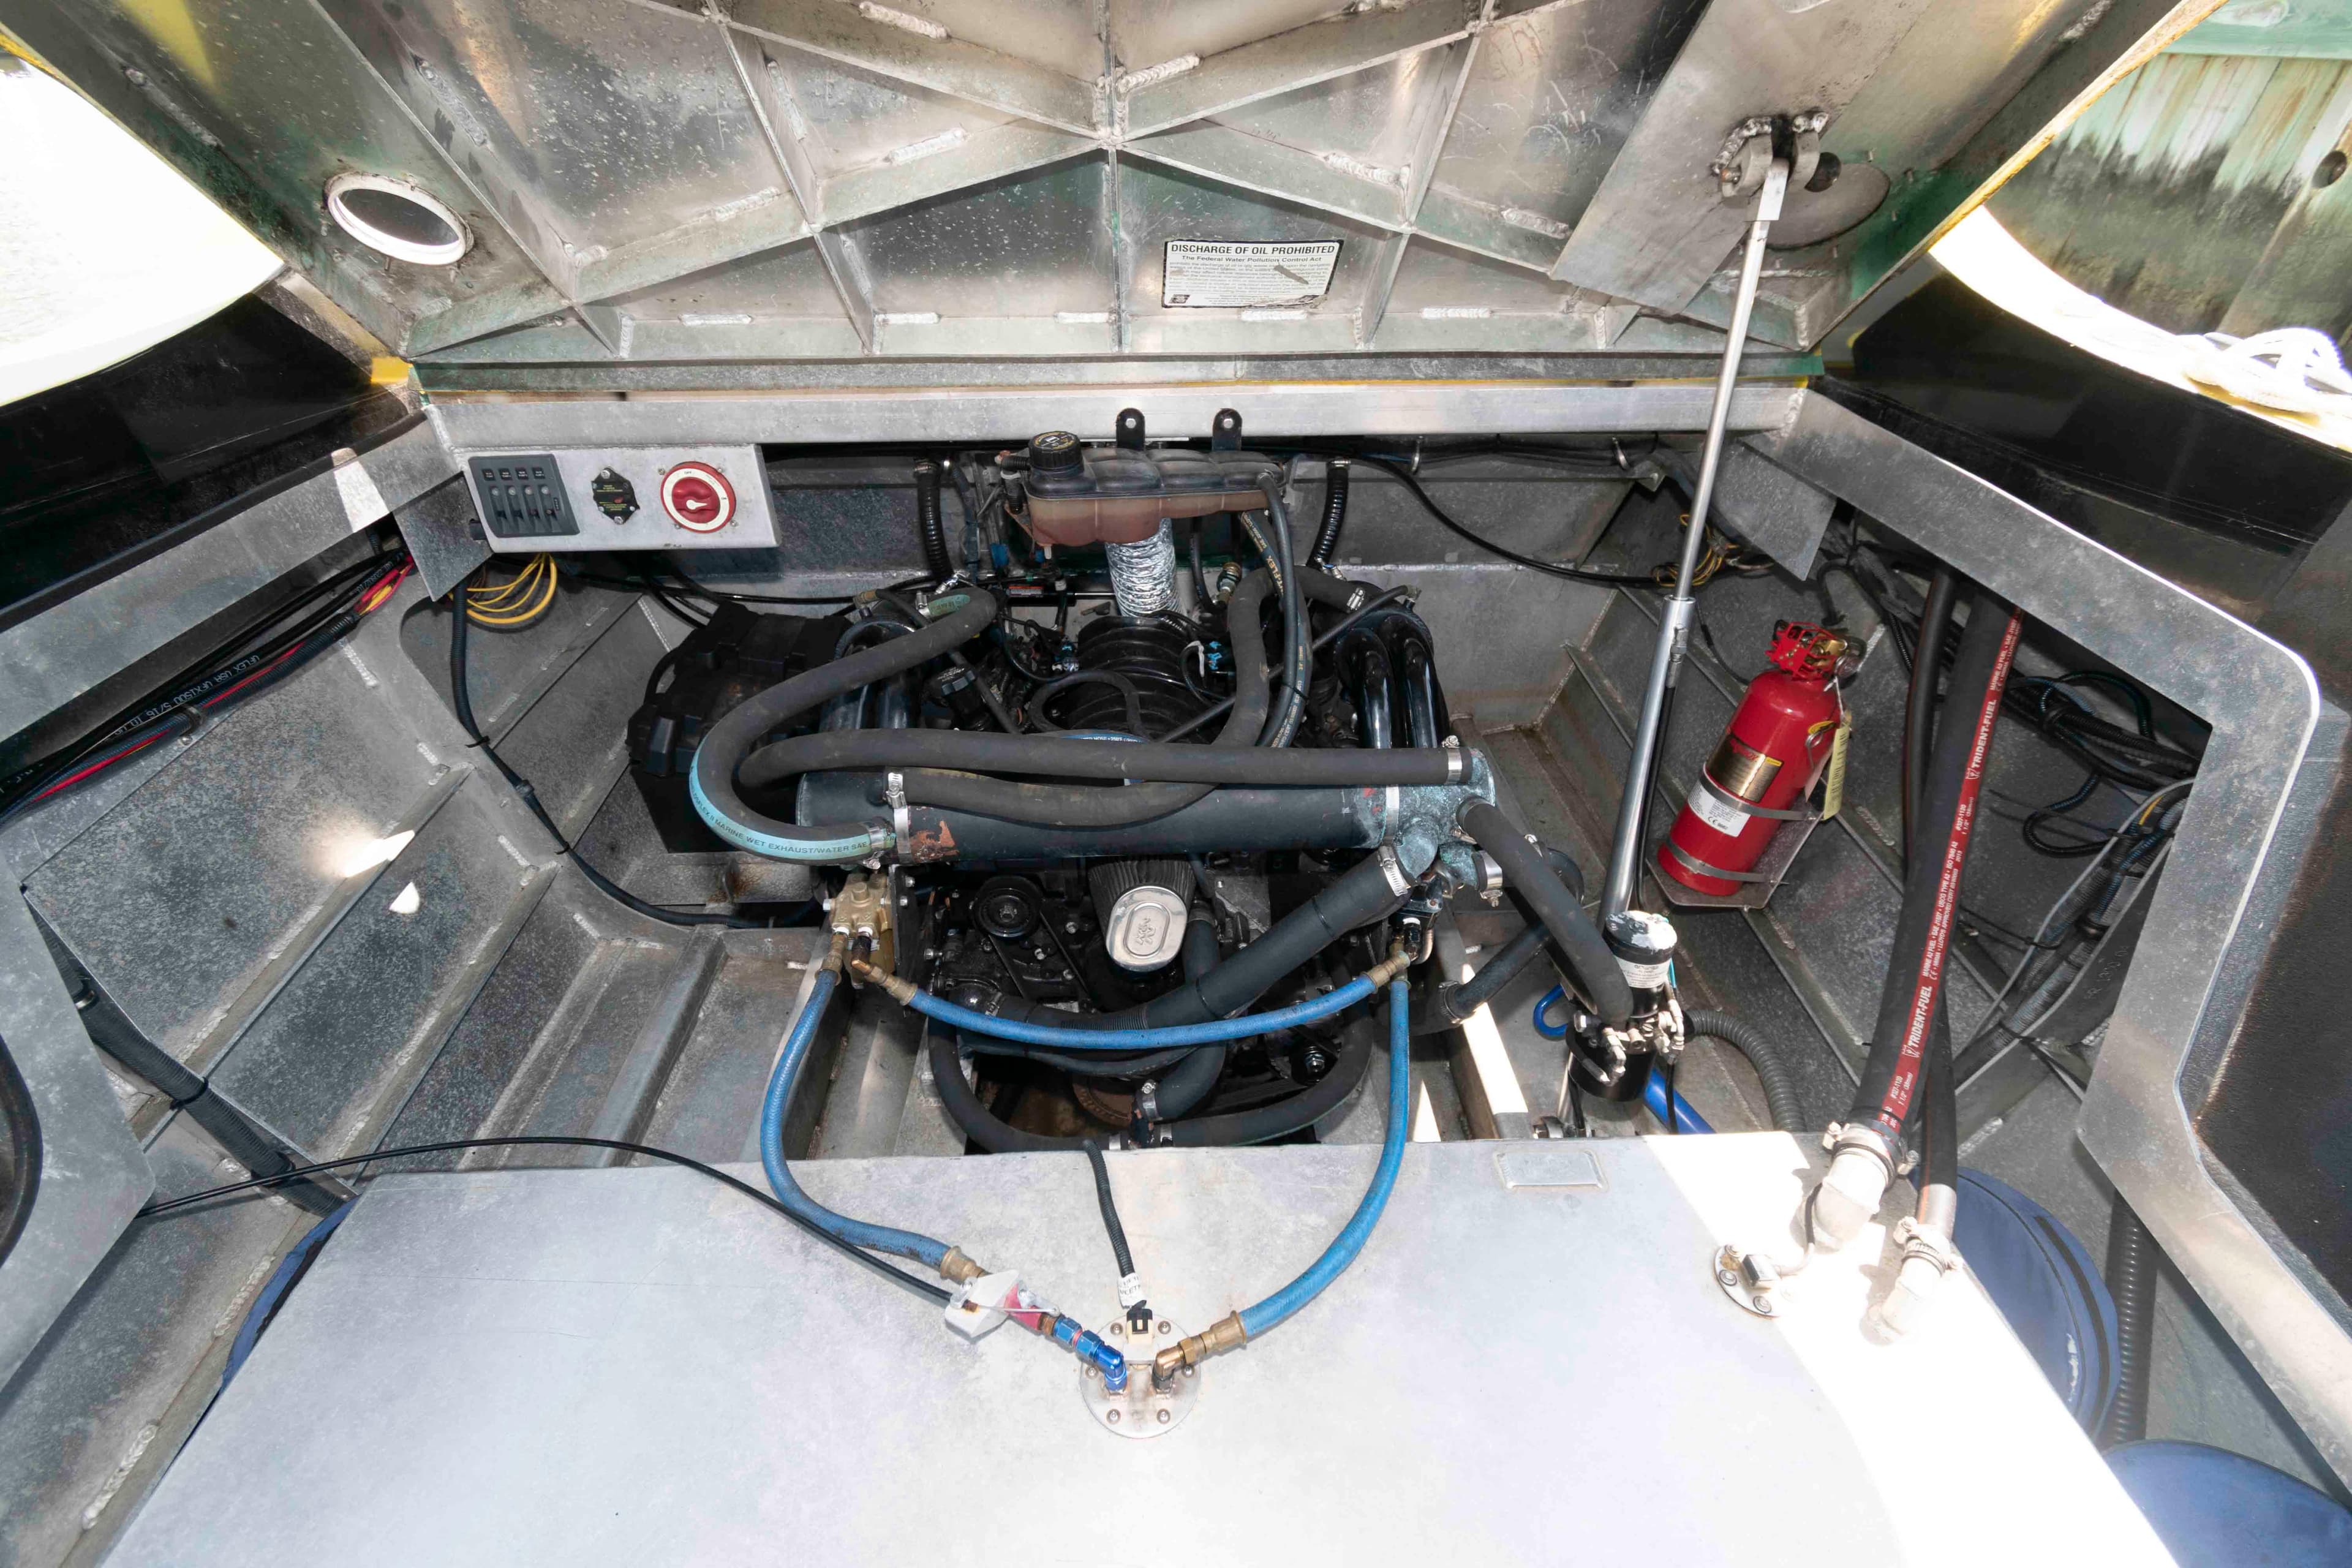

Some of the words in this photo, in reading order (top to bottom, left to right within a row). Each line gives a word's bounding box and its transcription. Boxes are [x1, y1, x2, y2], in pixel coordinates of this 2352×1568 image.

[1172, 244, 1232, 254] DISCHARGE
[1272, 246, 1335, 254] PROHIBITED
[213, 669, 232, 684] USA
[145, 699, 172, 720] 5/16
[1971, 698, 1997, 769] TRIDENT-FUEL
[715, 818, 744, 839] MARINE
[746, 835, 766, 847] WET
[769, 842, 849, 853] EXHAUST/WATER
[851, 842, 867, 851] SAE
[1907, 984, 1932, 1049] TRIDENT-FUEL
